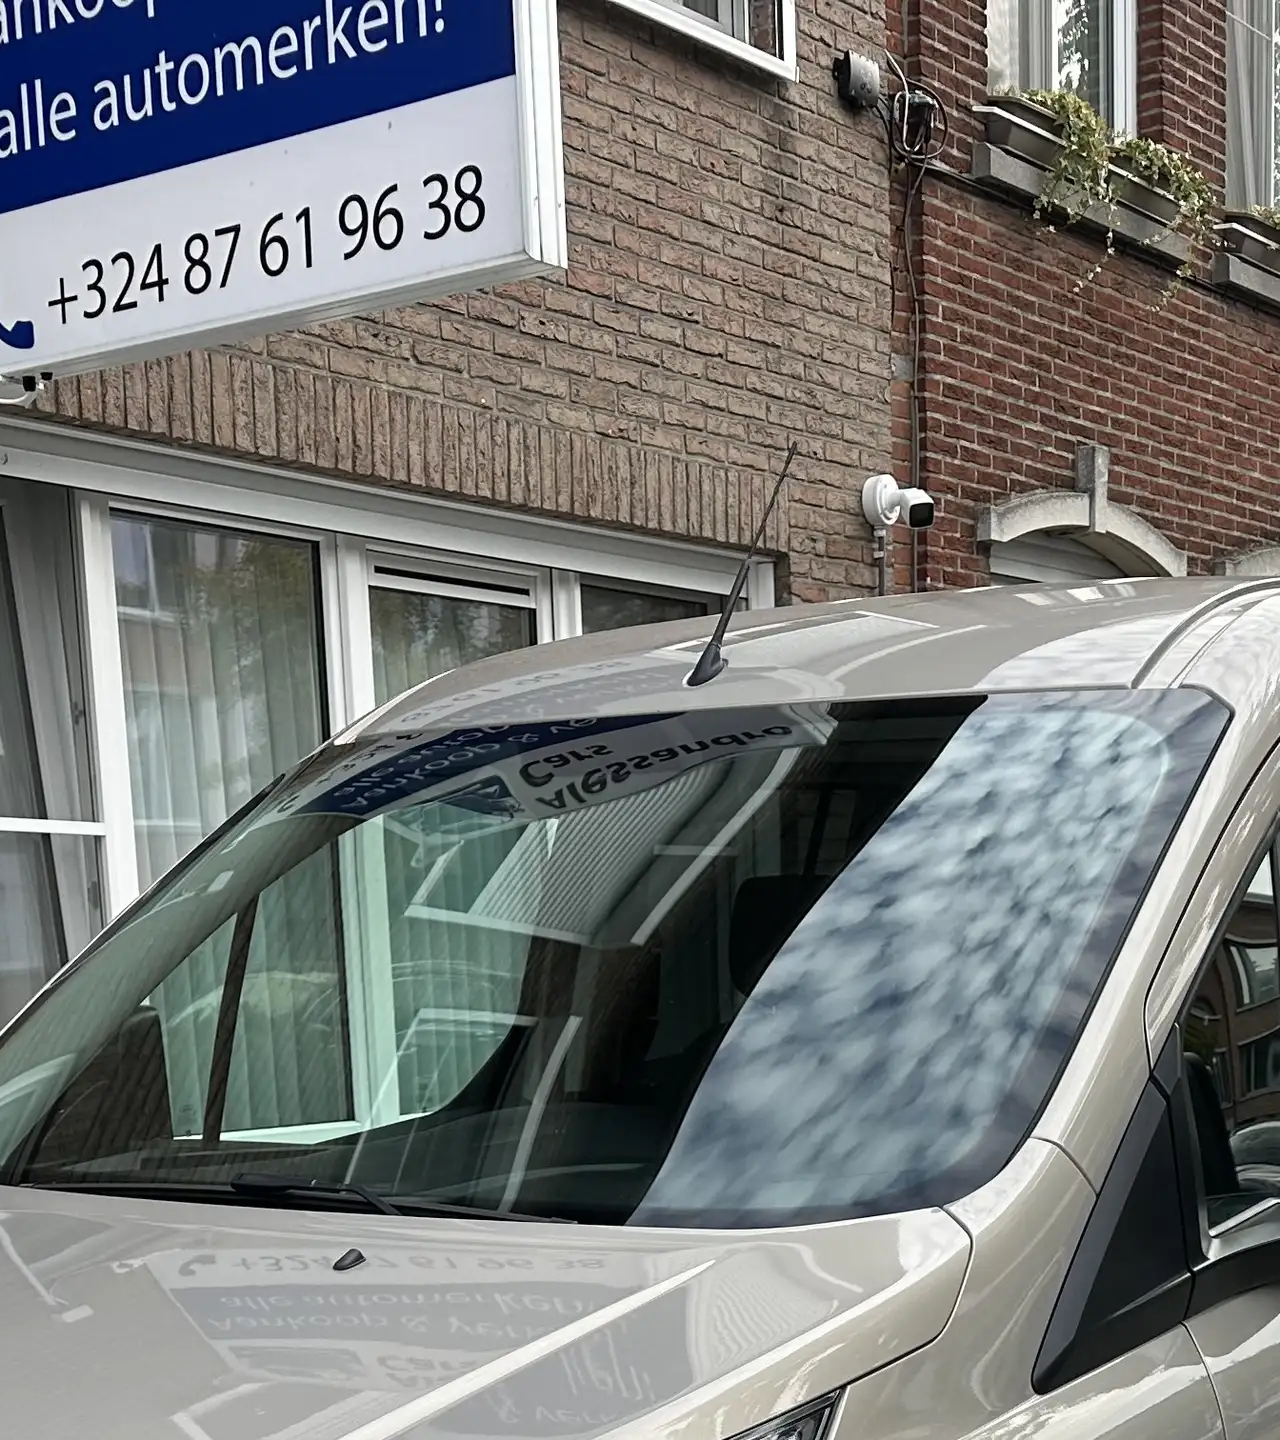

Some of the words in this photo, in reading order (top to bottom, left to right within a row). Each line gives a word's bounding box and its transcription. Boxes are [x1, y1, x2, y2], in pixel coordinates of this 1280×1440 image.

[48, 243, 169, 324] +324
[184, 224, 241, 295] 87
[260, 206, 312, 277] 61
[338, 183, 404, 261] 96
[422, 165, 486, 240] 38
